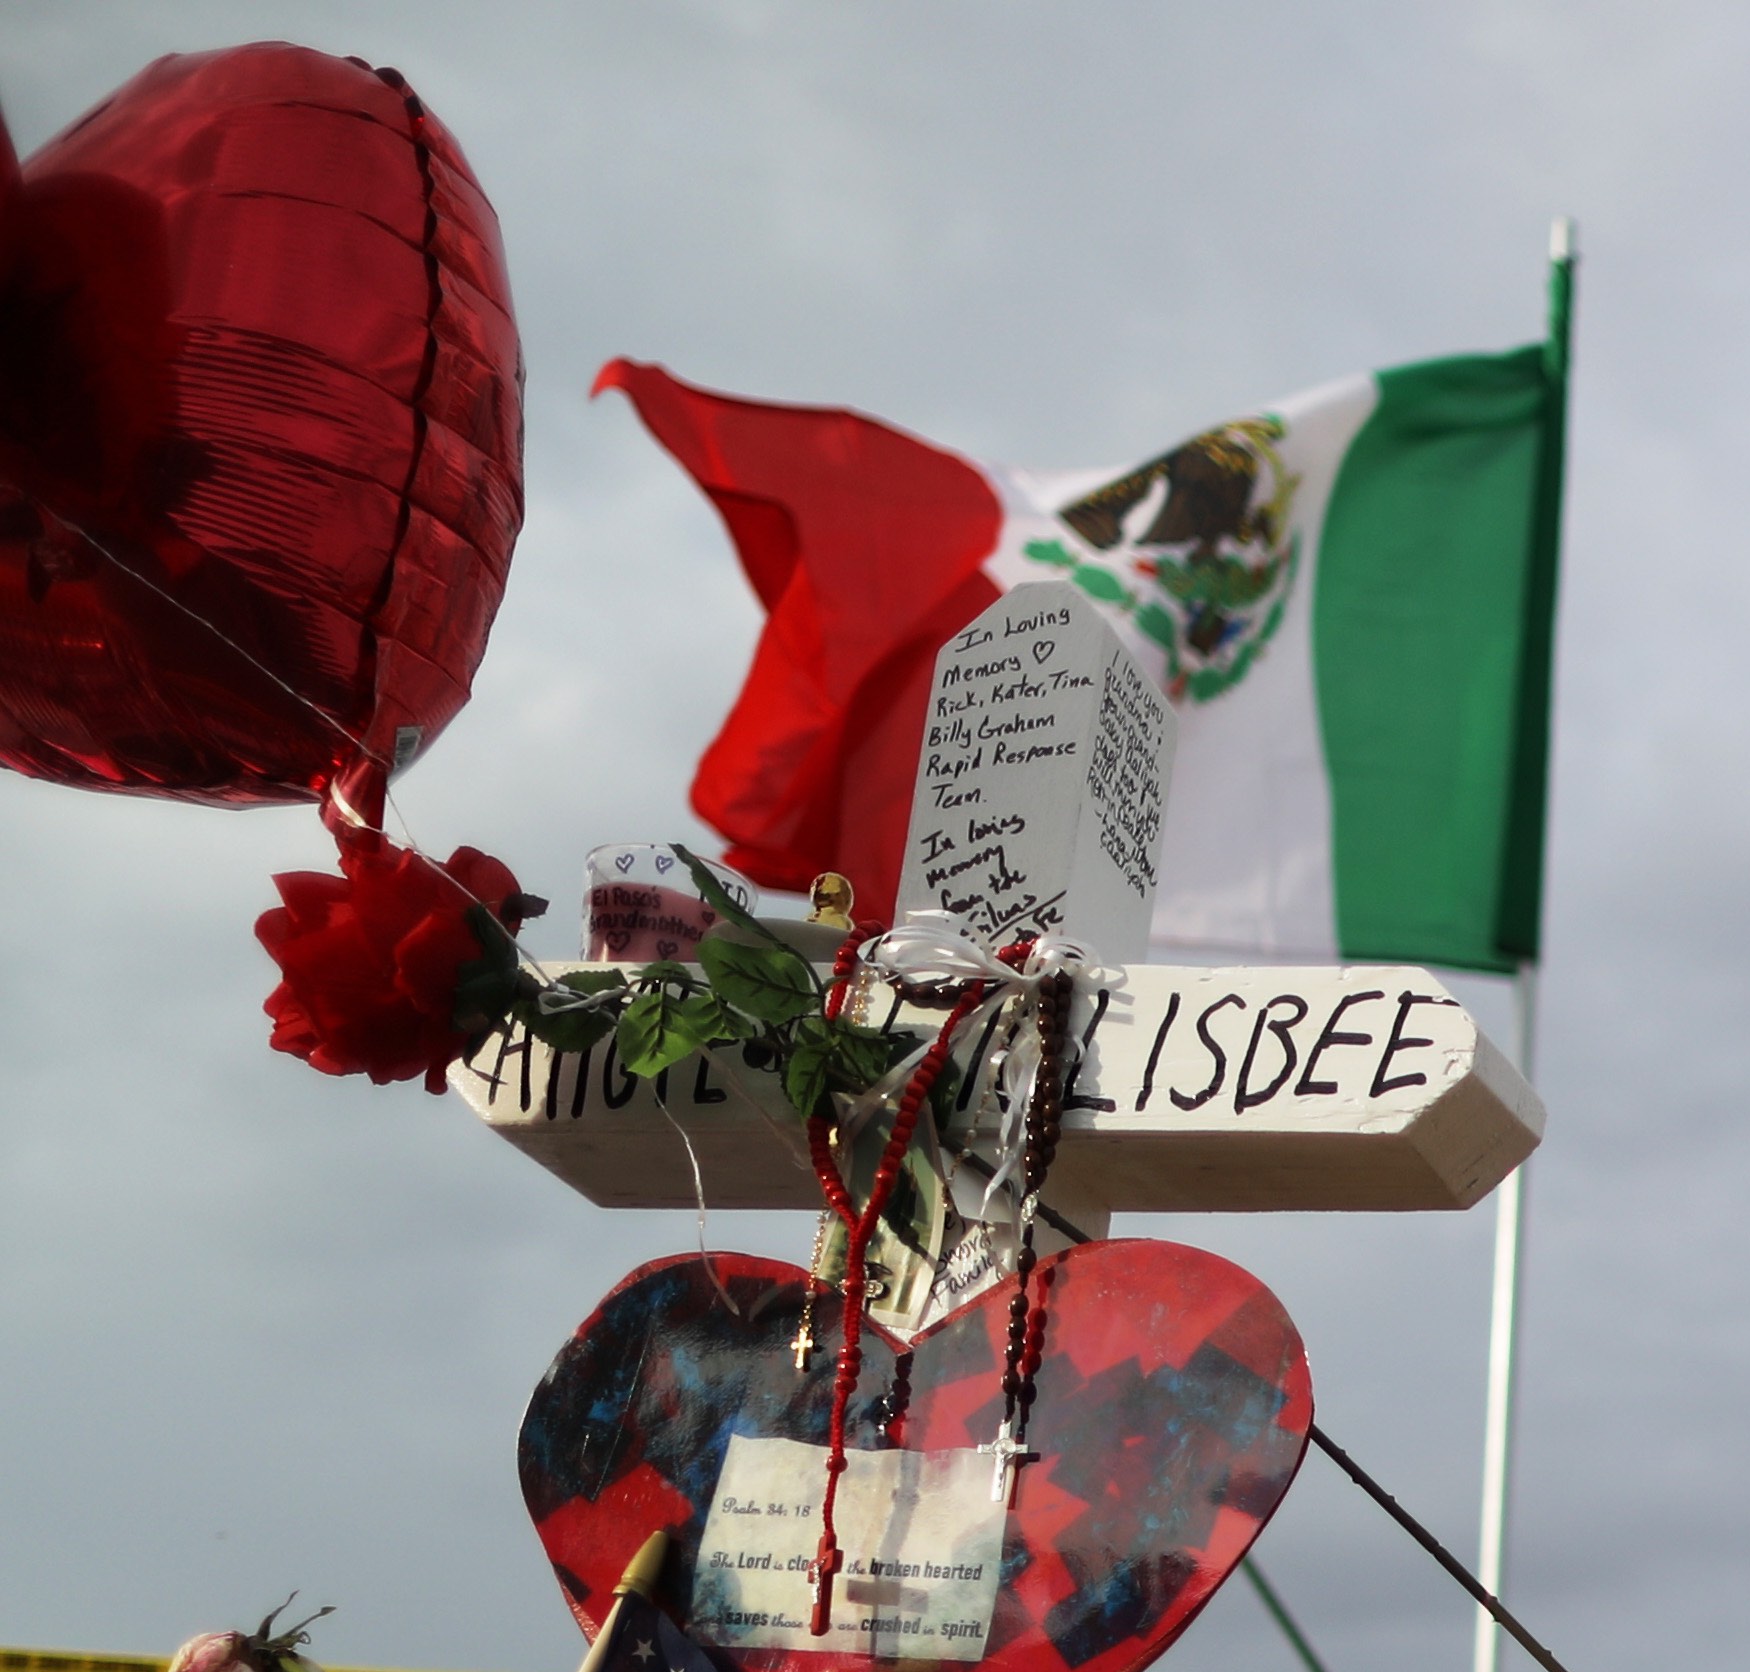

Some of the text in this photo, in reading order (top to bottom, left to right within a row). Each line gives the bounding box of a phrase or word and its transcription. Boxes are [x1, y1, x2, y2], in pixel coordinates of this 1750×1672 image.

[955, 607, 1071, 653] In Loving
[942, 655, 1021, 689] Memory
[1049, 669, 1095, 690] Tina
[929, 712, 1055, 749] Billy Graham
[926, 738, 1076, 780] Rapid Response
[920, 829, 956, 864] In
[872, 981, 1462, 1116] LISBEE
[722, 1497, 761, 1516] Psalm
[793, 1505, 811, 1517] 18
[710, 1551, 736, 1570] The
[738, 1552, 772, 1570] Lord
[787, 1553, 810, 1572] clo
[846, 1560, 867, 1575] the
[869, 1557, 920, 1578] broken
[924, 1561, 983, 1581] hearted
[725, 1612, 768, 1629] saves
[770, 1614, 804, 1630] those
[838, 1621, 859, 1632] are
[860, 1616, 920, 1635] crushed
[923, 1623, 935, 1636] in
[940, 1620, 983, 1640] spirit.
